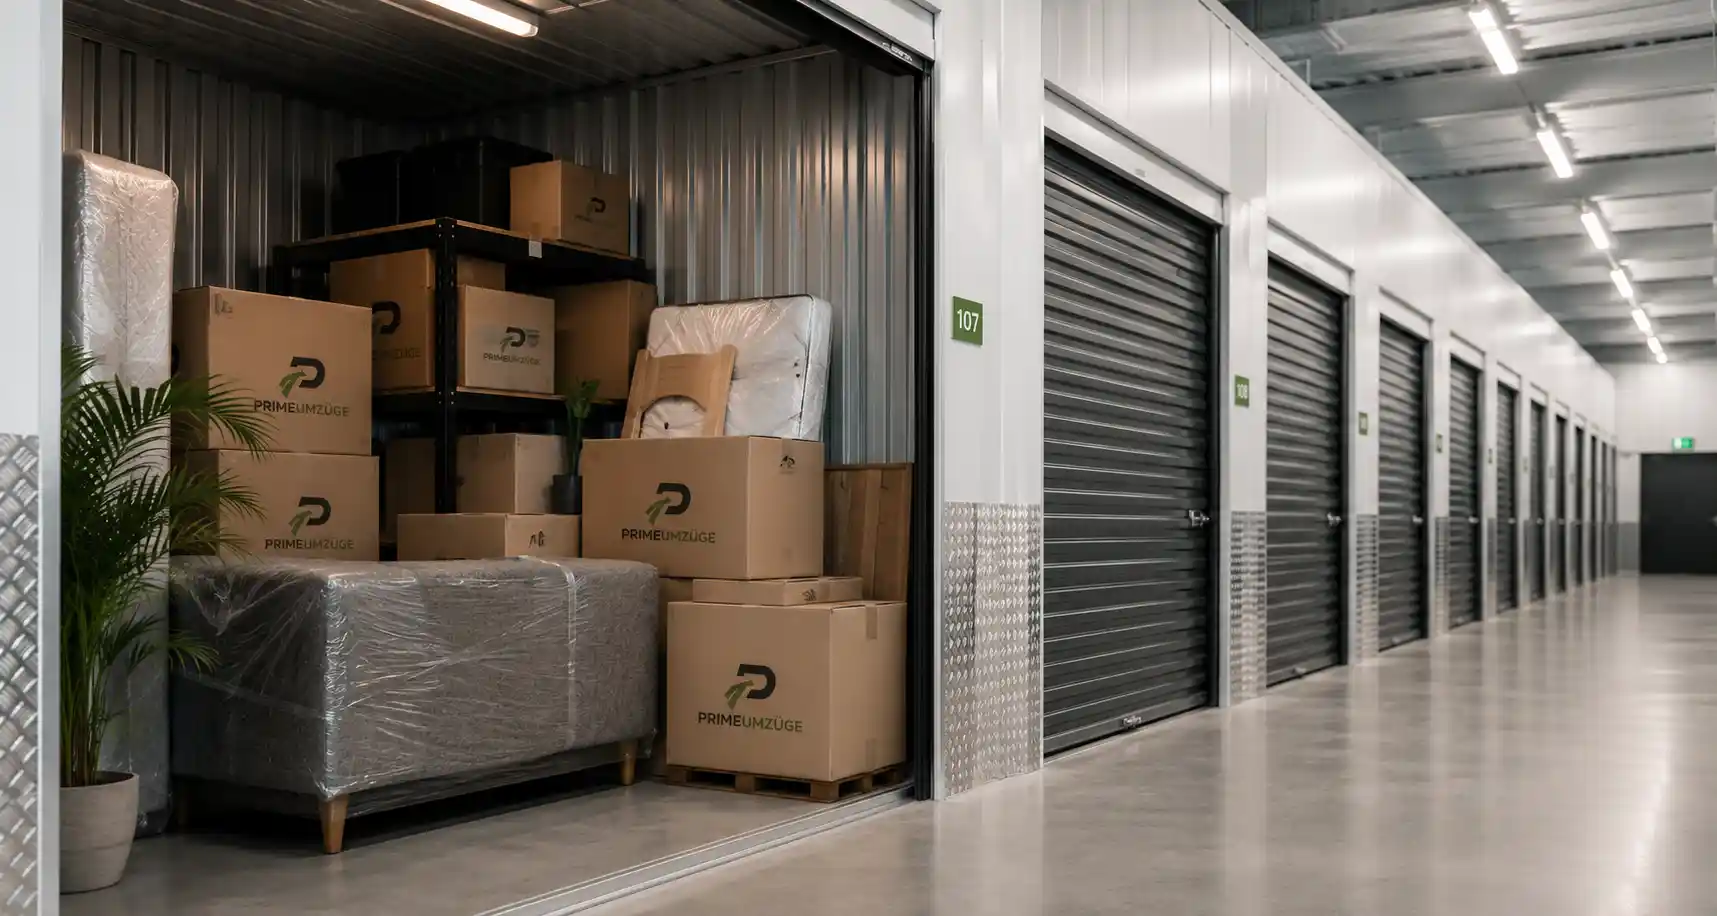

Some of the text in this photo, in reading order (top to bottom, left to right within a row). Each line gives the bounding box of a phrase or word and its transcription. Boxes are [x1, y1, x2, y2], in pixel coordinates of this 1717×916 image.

[956, 308, 980, 333] 107
[254, 399, 350, 417] PRIMEUMZÜGE
[621, 526, 716, 544] PRIMEUMZÜGE
[697, 711, 803, 733] PRIMEUMZÜGE
